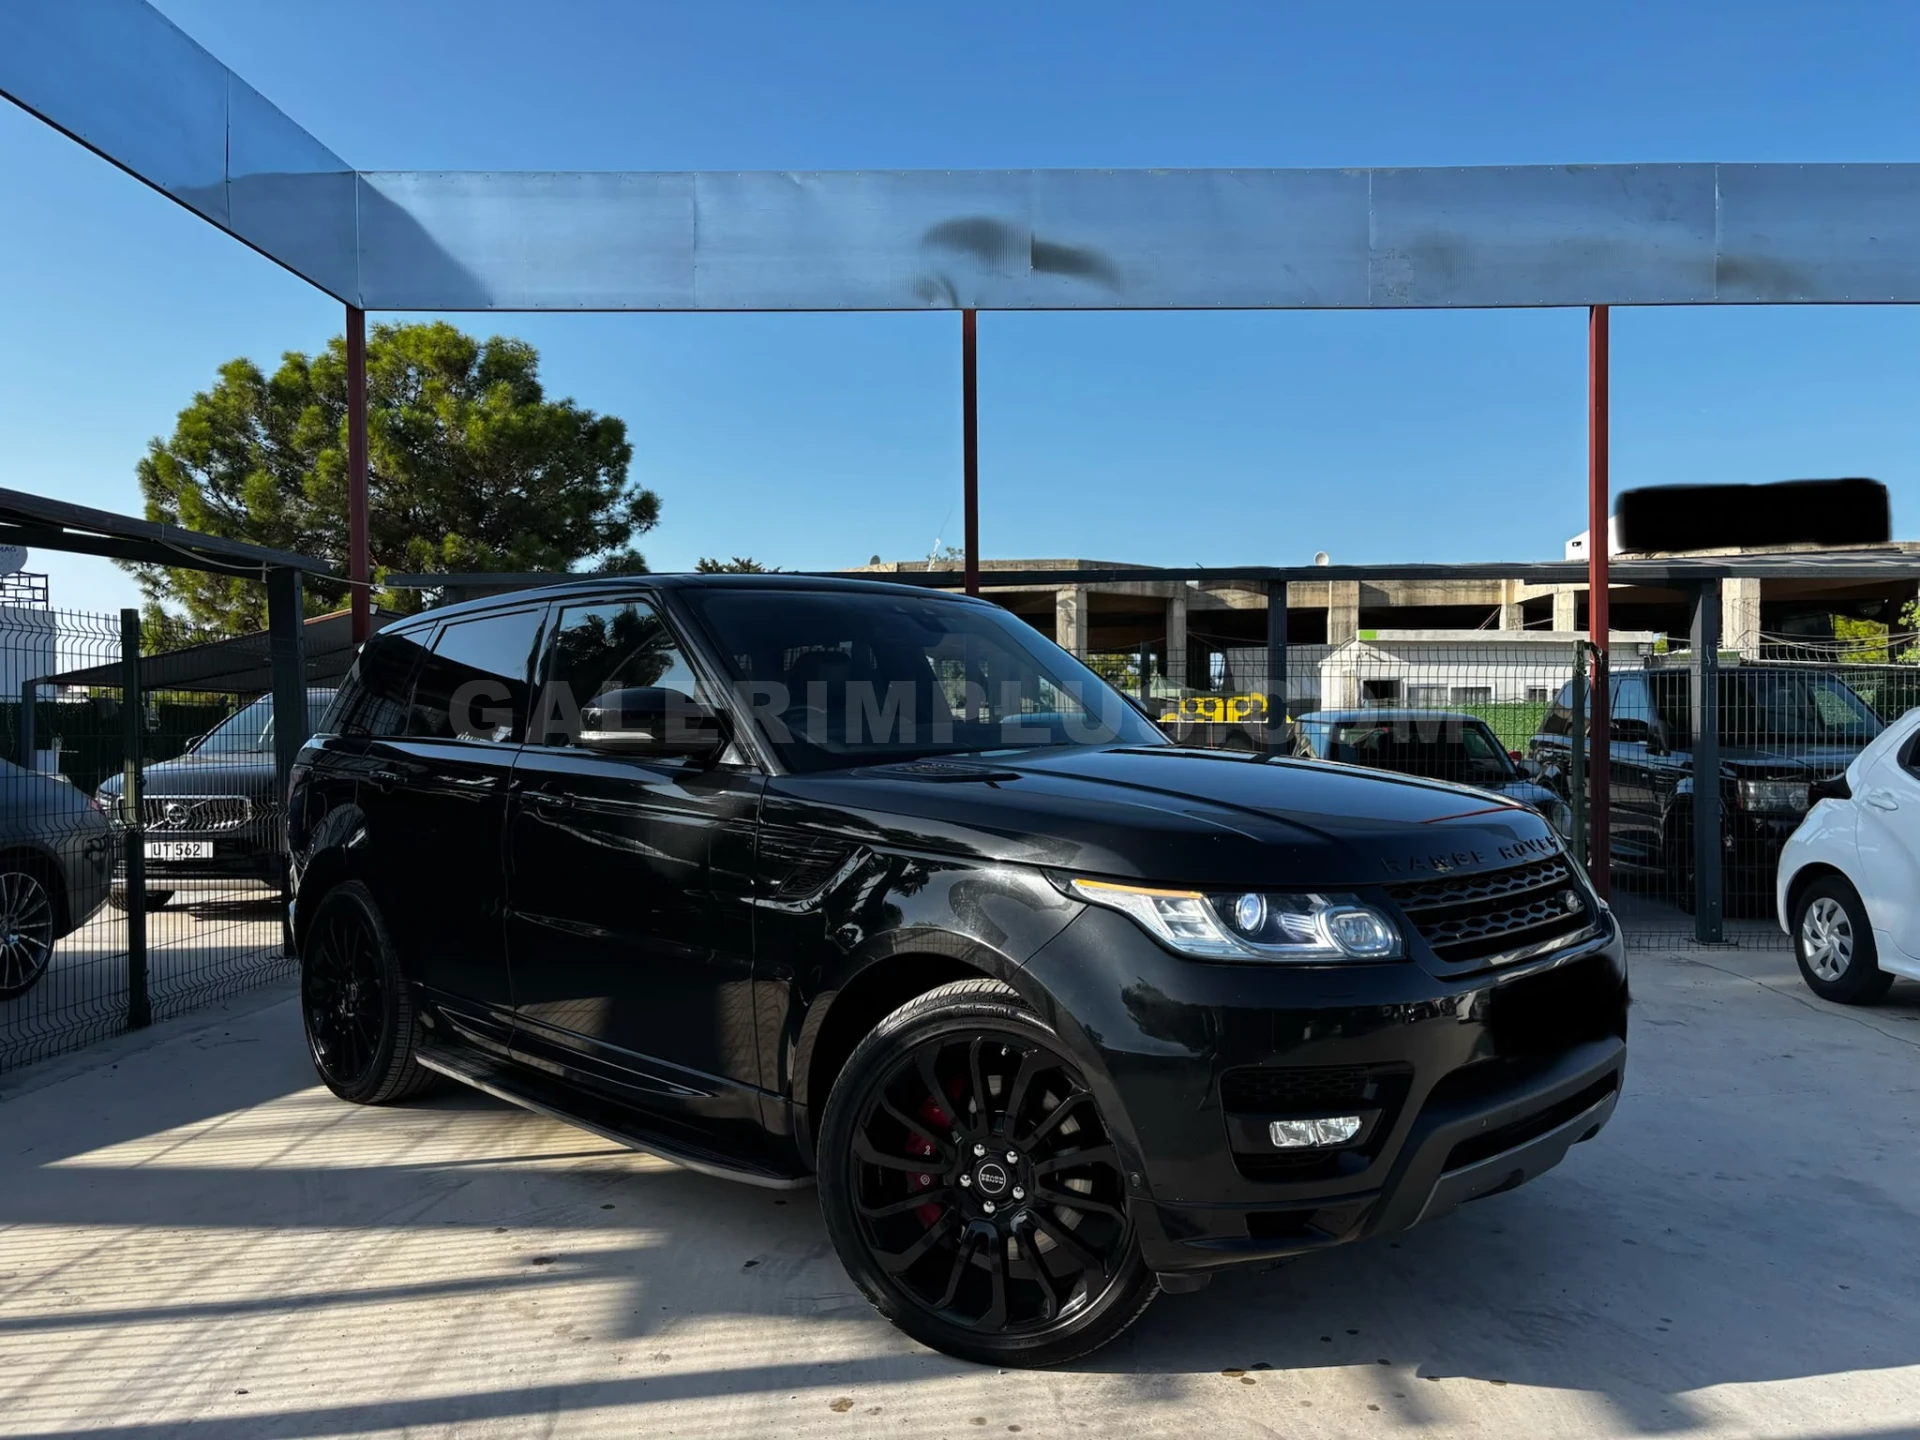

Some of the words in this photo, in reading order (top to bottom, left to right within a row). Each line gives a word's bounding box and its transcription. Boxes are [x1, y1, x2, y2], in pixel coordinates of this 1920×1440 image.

[153, 843, 171, 856] UT
[175, 843, 200, 856] 562
[1380, 850, 1488, 873] RANGE
